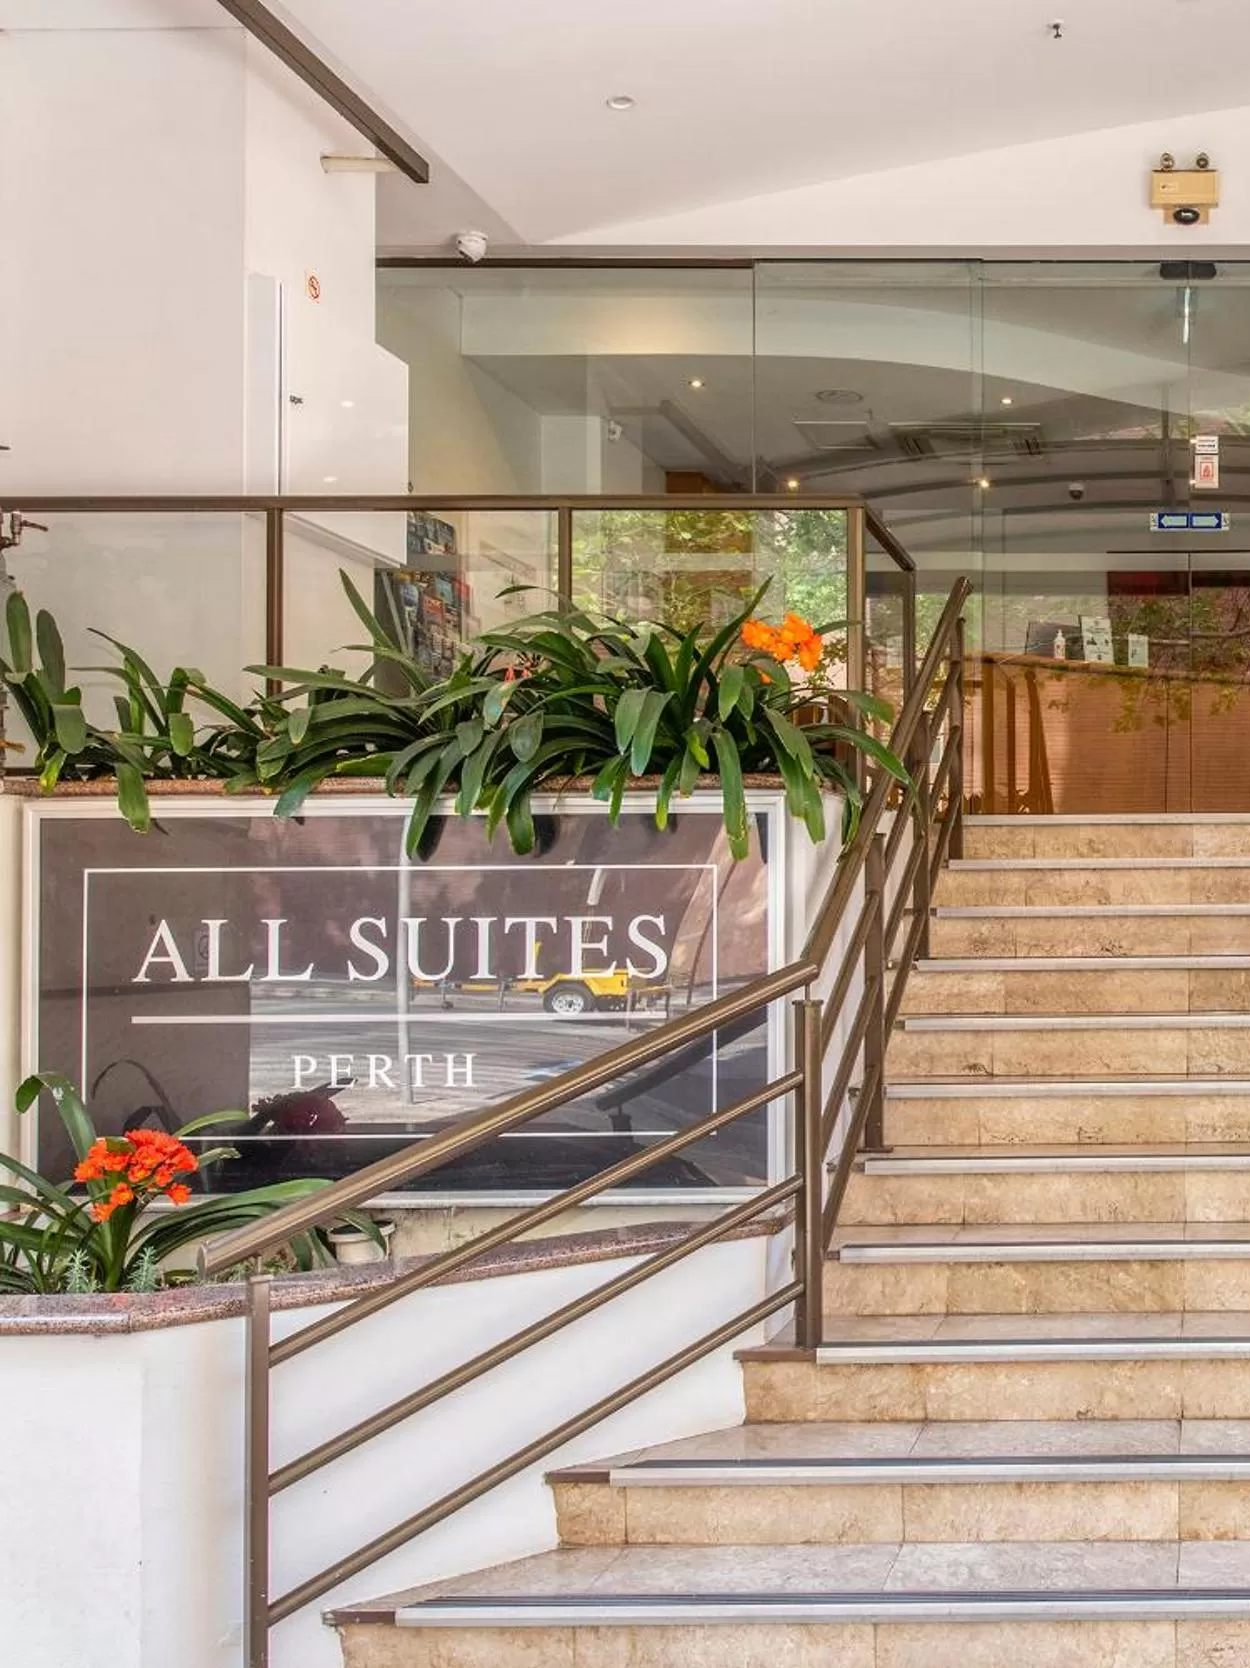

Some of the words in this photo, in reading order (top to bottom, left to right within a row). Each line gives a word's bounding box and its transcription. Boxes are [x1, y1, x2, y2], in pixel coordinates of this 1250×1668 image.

[132, 919, 313, 982] ALL
[347, 915, 668, 980] SUITES
[290, 1053, 477, 1089] PERTH
